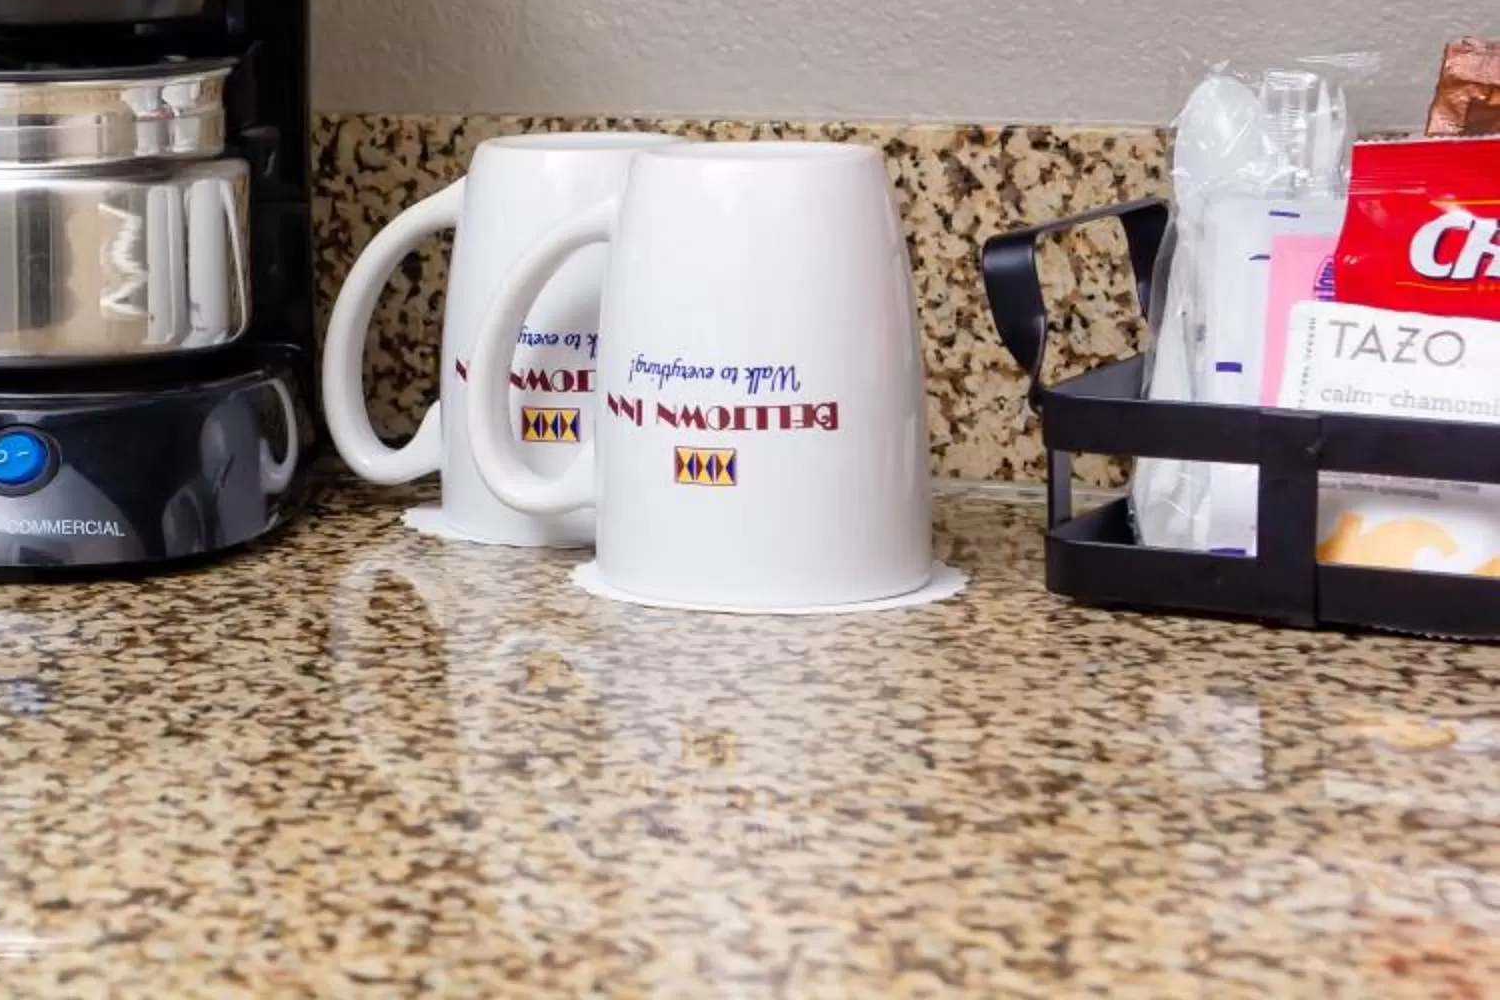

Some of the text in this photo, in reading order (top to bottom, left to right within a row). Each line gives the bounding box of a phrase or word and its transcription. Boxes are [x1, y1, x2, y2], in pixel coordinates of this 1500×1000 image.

[565, 331, 581, 350] to
[1327, 319, 1466, 367] TAZO
[509, 367, 596, 393] TOWN
[628, 353, 801, 394] Walk to everything!
[656, 401, 839, 431] BELLTOWN
[6, 518, 126, 537] COMMERCIAL
